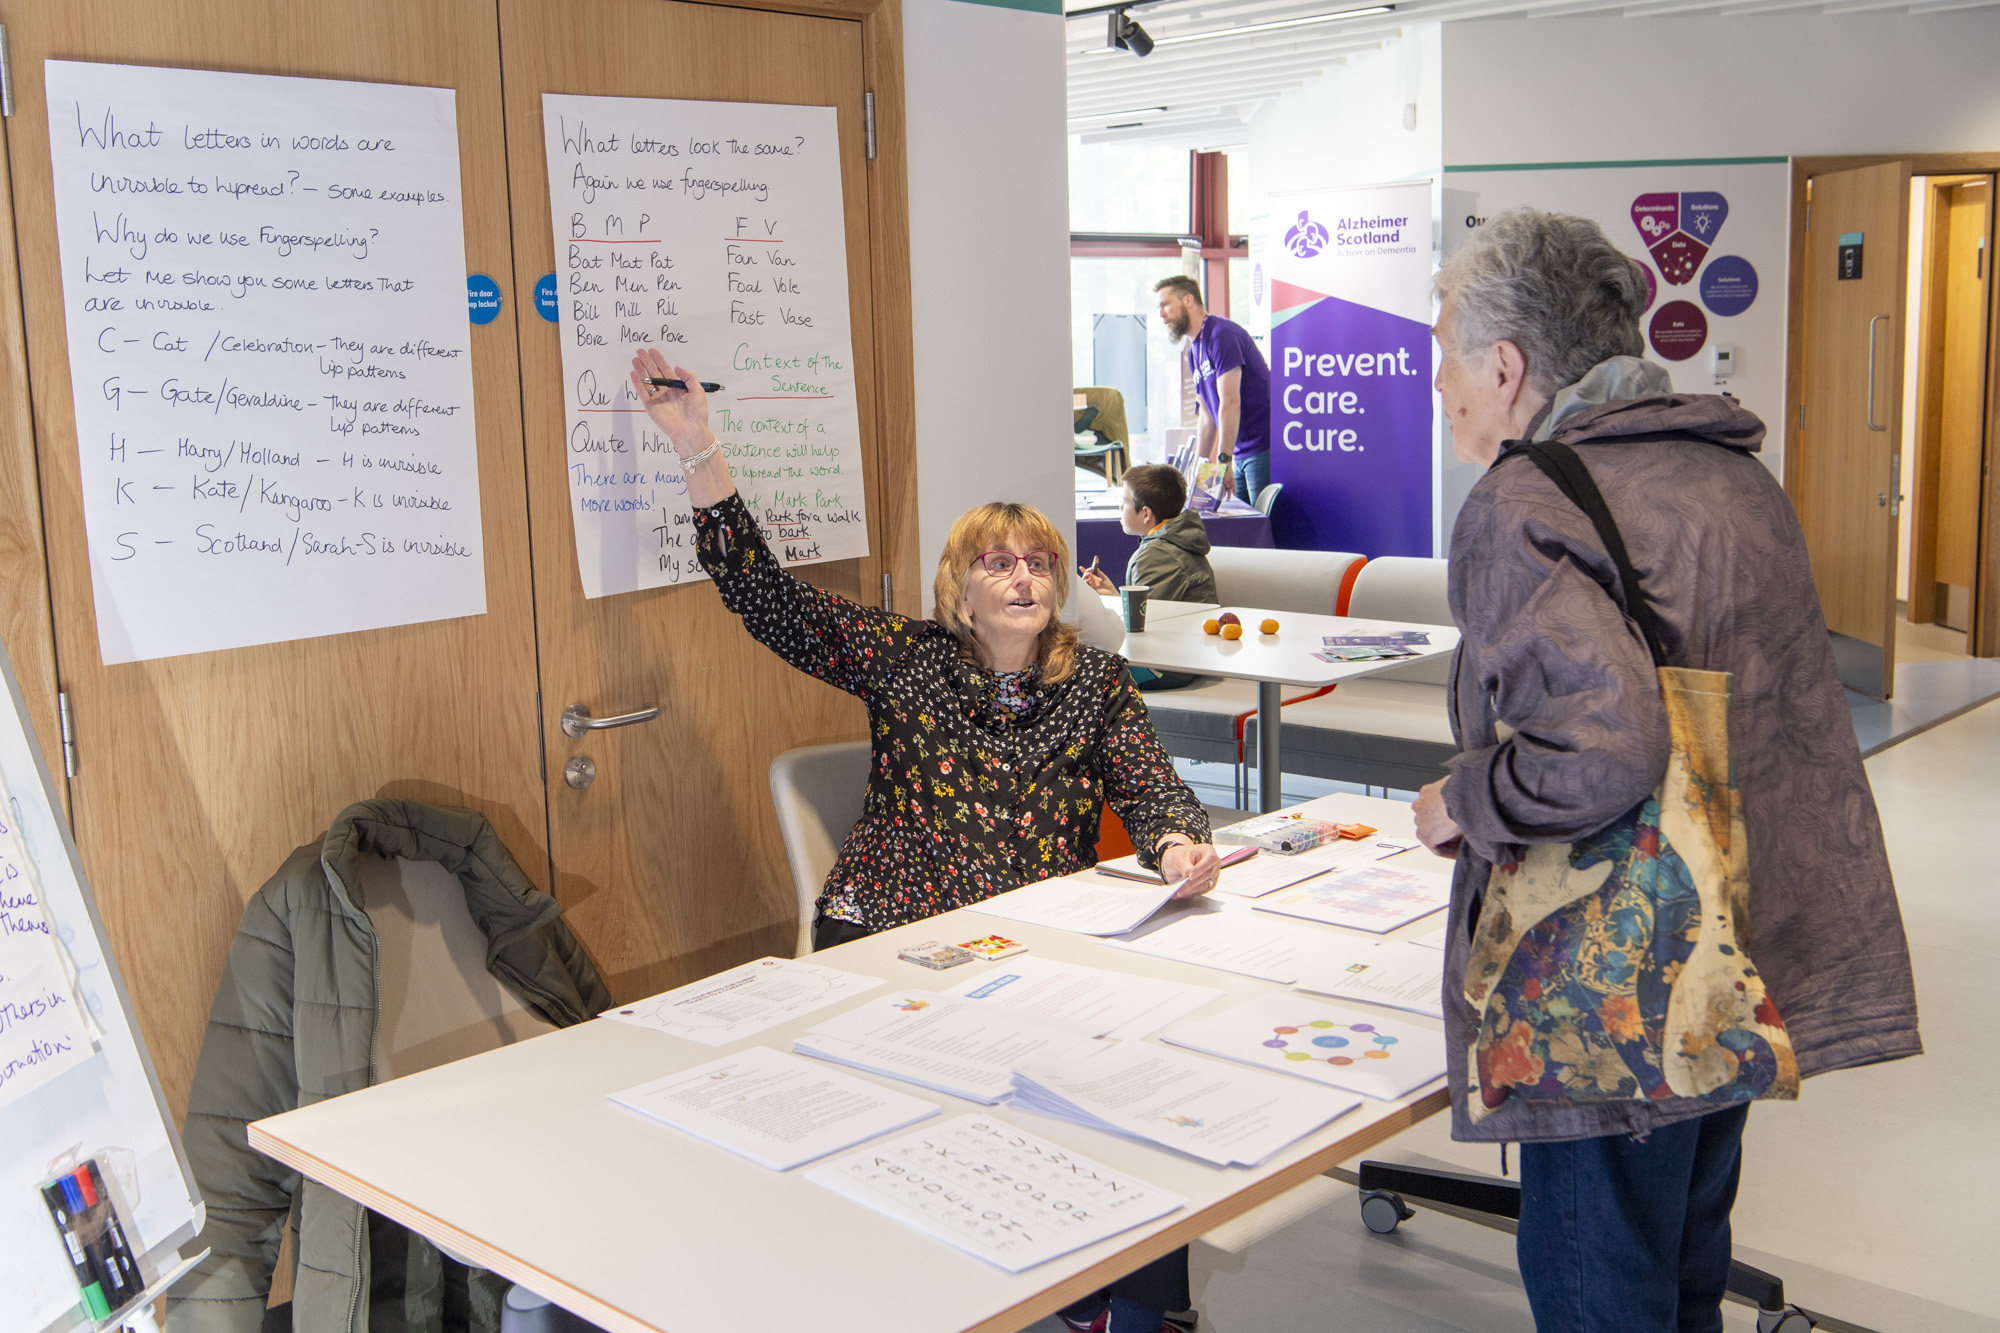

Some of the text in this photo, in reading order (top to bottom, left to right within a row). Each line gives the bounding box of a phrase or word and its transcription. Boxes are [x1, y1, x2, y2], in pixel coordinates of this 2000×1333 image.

[76, 101, 395, 151] What letters in words are
[561, 115, 619, 155] What
[631, 132, 679, 156] letters
[689, 137, 720, 155] look
[755, 136, 804, 156] same?
[187, 176, 208, 193] to
[379, 190, 449, 206] examples.
[573, 162, 619, 204] Again
[626, 177, 644, 190] we
[653, 179, 673, 190] use
[571, 213, 650, 238] B M P
[736, 216, 777, 237] F V
[1337, 215, 1408, 231] Alzheimer
[1465, 215, 1489, 228] Ou
[93, 211, 147, 260] Why
[155, 228, 178, 243] do
[187, 232, 213, 244] we
[1337, 230, 1400, 246] Scotland
[568, 244, 674, 269] Bat Mat Pat
[726, 245, 795, 266] Fan Van
[1336, 249, 1362, 257] Action
[1377, 246, 1416, 255] Dementia
[86, 256, 132, 283] Let
[231, 275, 267, 298] you
[326, 277, 373, 290] letters
[570, 272, 604, 293] Ben
[615, 276, 648, 292] Men
[657, 275, 681, 291] Pen
[728, 272, 800, 295] Foal Vole
[85, 297, 125, 311] are
[478, 300, 497, 308] locked
[542, 299, 555, 307] keep
[573, 297, 678, 321] Bill Mill Pill
[731, 301, 813, 327] Fast Vase
[98, 327, 116, 353] C
[153, 332, 189, 352] Cat
[370, 344, 395, 354] are
[400, 339, 463, 360] different
[577, 323, 688, 347] Bore More Pore
[734, 342, 801, 370] Context
[807, 352, 819, 375] of
[1284, 346, 1417, 377] Prevent.
[348, 365, 406, 379] patterns
[577, 369, 611, 406] Qu
[771, 375, 829, 394] Sentence
[104, 377, 119, 411] G
[363, 402, 388, 413] are
[393, 398, 461, 419] different
[1283, 384, 1365, 414] Care.
[362, 422, 420, 437] patterns
[716, 410, 825, 440] The context of a
[1283, 421, 1364, 452] Cure.
[571, 421, 629, 453] Quite
[111, 433, 125, 462] H
[343, 453, 353, 467] H
[363, 456, 372, 468] is
[378, 456, 442, 475] invisible
[786, 444, 807, 457] will
[811, 444, 839, 461] help
[571, 463, 616, 486] There
[623, 472, 647, 485] are
[810, 465, 843, 476] word.
[117, 478, 134, 504] K
[355, 488, 371, 508] K
[374, 492, 383, 508] is
[614, 491, 654, 512] words!
[774, 490, 807, 508] Mark
[816, 489, 843, 509] Park
[765, 509, 794, 522] Park
[828, 510, 863, 523] walk.
[652, 526, 683, 548] The
[779, 524, 811, 538] bark.
[111, 532, 138, 560] S
[382, 538, 394, 555] is
[404, 535, 472, 558] invisible
[785, 542, 822, 561] Mark
[659, 554, 703, 583] My so
[875, 1157, 942, 1193] A B C D
[1063, 1164, 1086, 1173] X
[1104, 1181, 1126, 1192] Z
